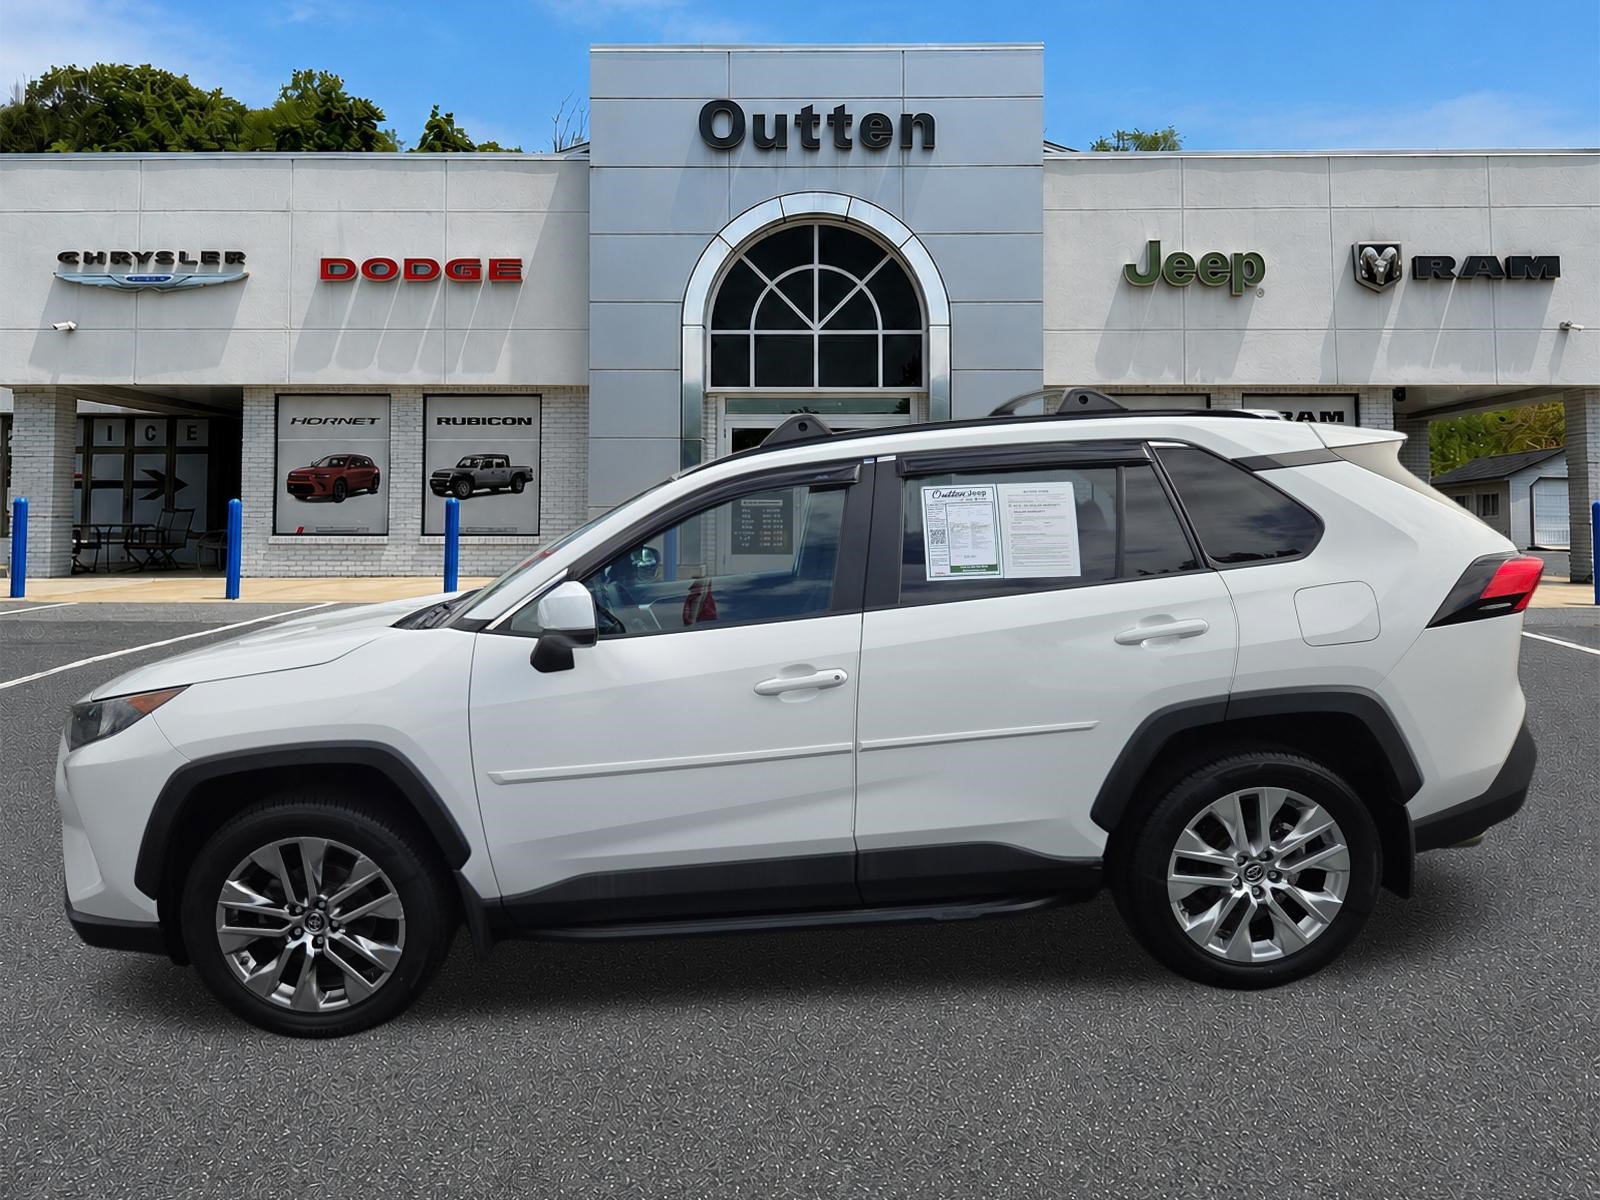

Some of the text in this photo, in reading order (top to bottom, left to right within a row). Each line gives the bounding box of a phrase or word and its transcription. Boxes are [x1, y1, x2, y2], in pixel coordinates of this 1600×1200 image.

[699, 99, 935, 149] Outten
[57, 250, 247, 266] CHRYSLER
[1123, 239, 1266, 297] Jeep
[1412, 255, 1561, 280] RAM
[319, 257, 523, 282] DODGE
[290, 417, 381, 426] HORNET
[436, 416, 533, 426] RUBICON
[932, 489, 966, 499] Outten
